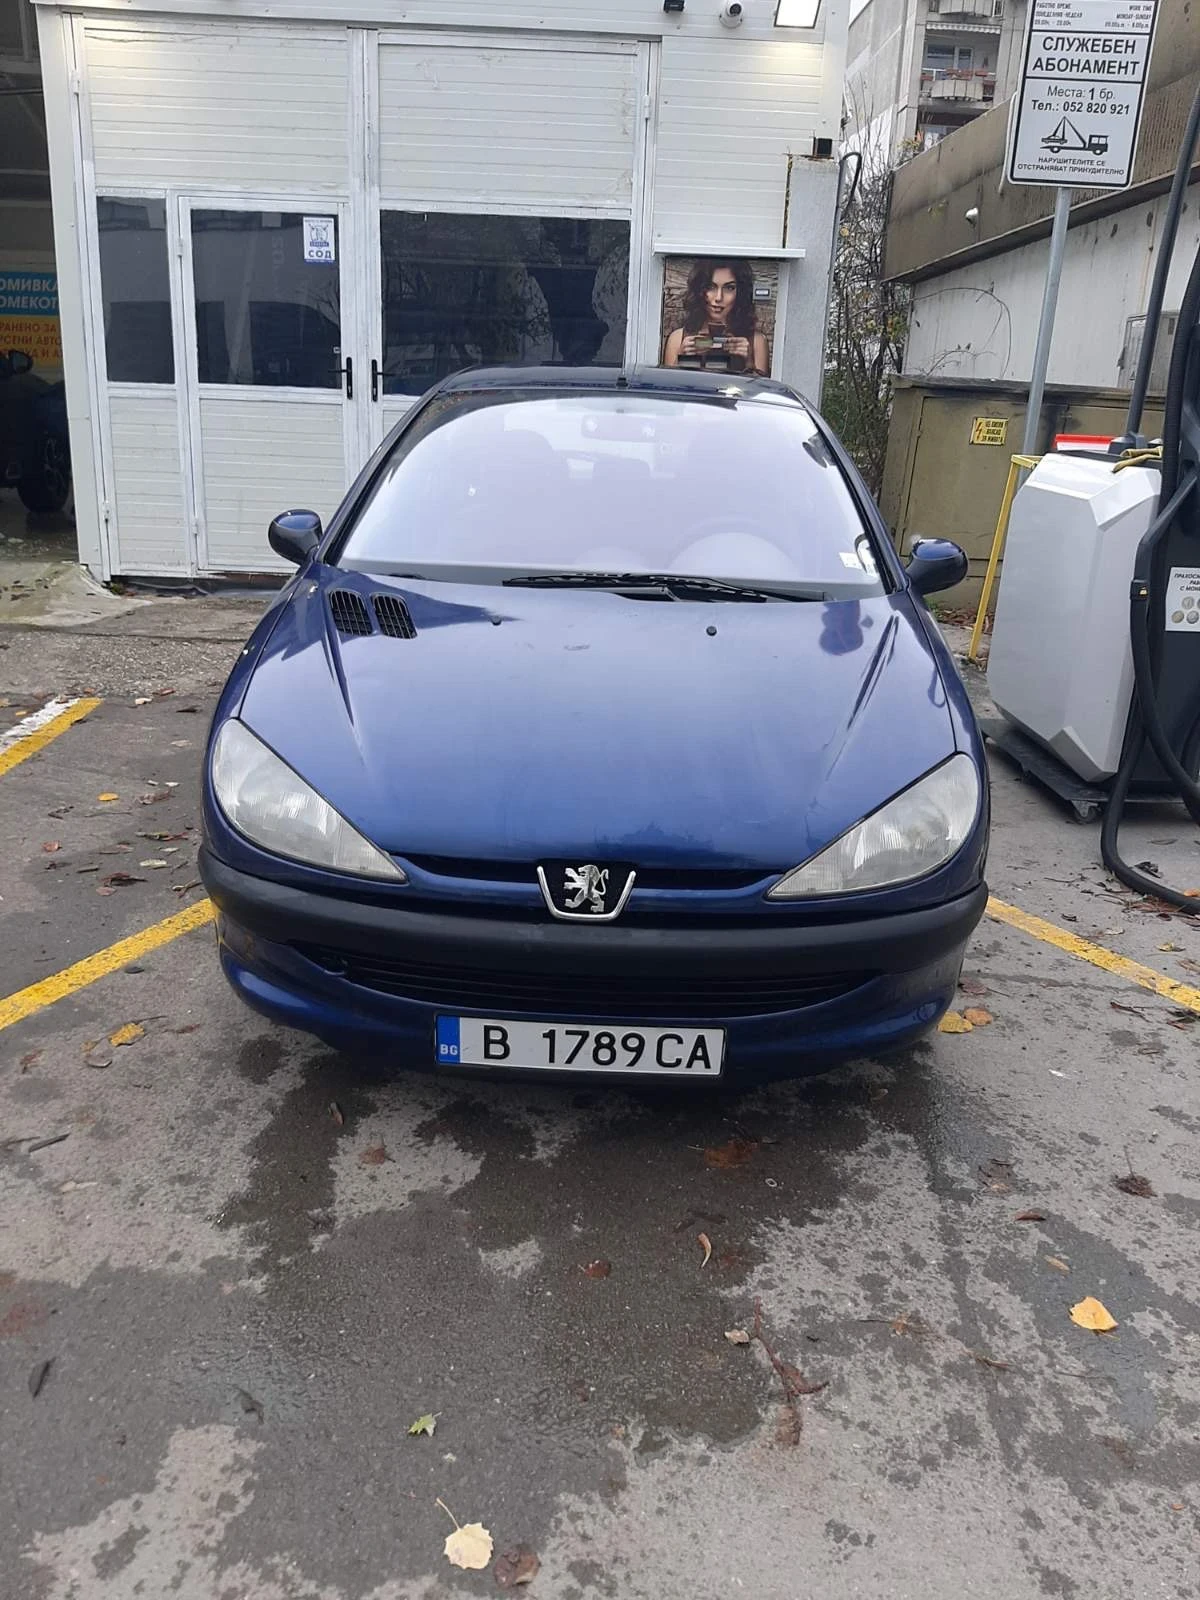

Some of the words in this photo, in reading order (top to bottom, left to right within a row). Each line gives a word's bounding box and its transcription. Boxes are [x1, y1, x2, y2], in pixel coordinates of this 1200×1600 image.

[1042, 36, 1136, 54] СЛУЖЕБЕН
[1032, 57, 1140, 75] АБОНАМЕНТ
[1047, 85, 1086, 99] Места:
[1088, 87, 1095, 100] 1
[1099, 87, 1116, 101] бр.
[1031, 99, 1059, 111] Тел.:
[1063, 101, 1083, 112] 052
[1086, 102, 1107, 114] 820
[1110, 103, 1130, 115] 921
[1017, 163, 1067, 172] ОТСТРАНЯВАТ
[1068, 165, 1125, 175] ПРИНУДИТЕЛНО
[1038, 157, 1095, 166] НАРУШИТЕЛИТЕ
[439, 1044, 458, 1056] BG
[482, 1024, 510, 1060] B
